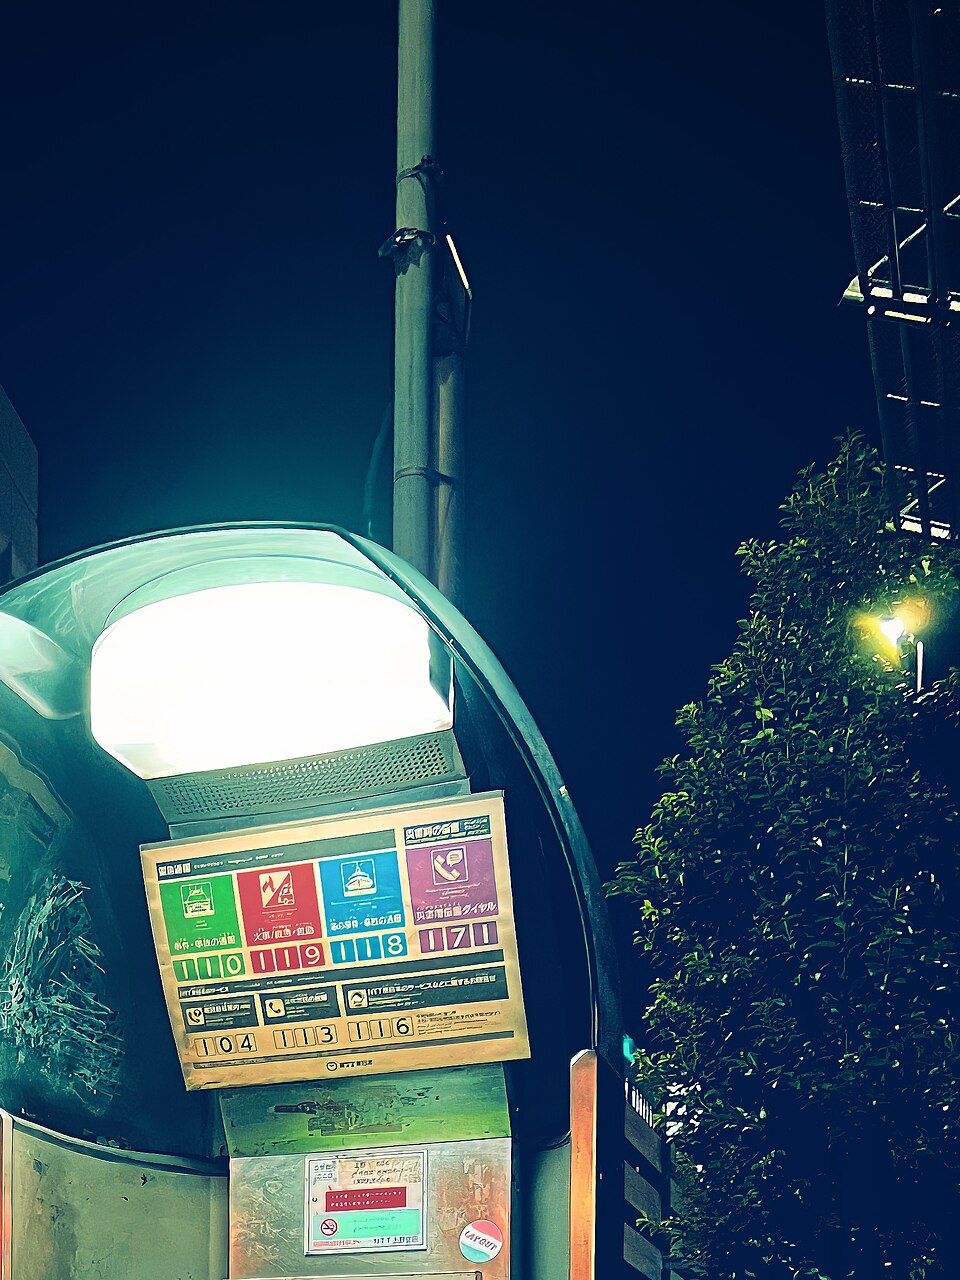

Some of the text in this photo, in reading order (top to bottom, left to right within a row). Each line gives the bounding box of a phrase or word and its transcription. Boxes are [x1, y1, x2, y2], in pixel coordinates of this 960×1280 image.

[341, 934, 404, 962] 118
[427, 923, 489, 951] 171
[181, 954, 242, 980] 110
[259, 945, 321, 971] 119
[281, 1026, 334, 1048] 113
[357, 1017, 410, 1040] 116
[203, 1034, 253, 1056] 104
